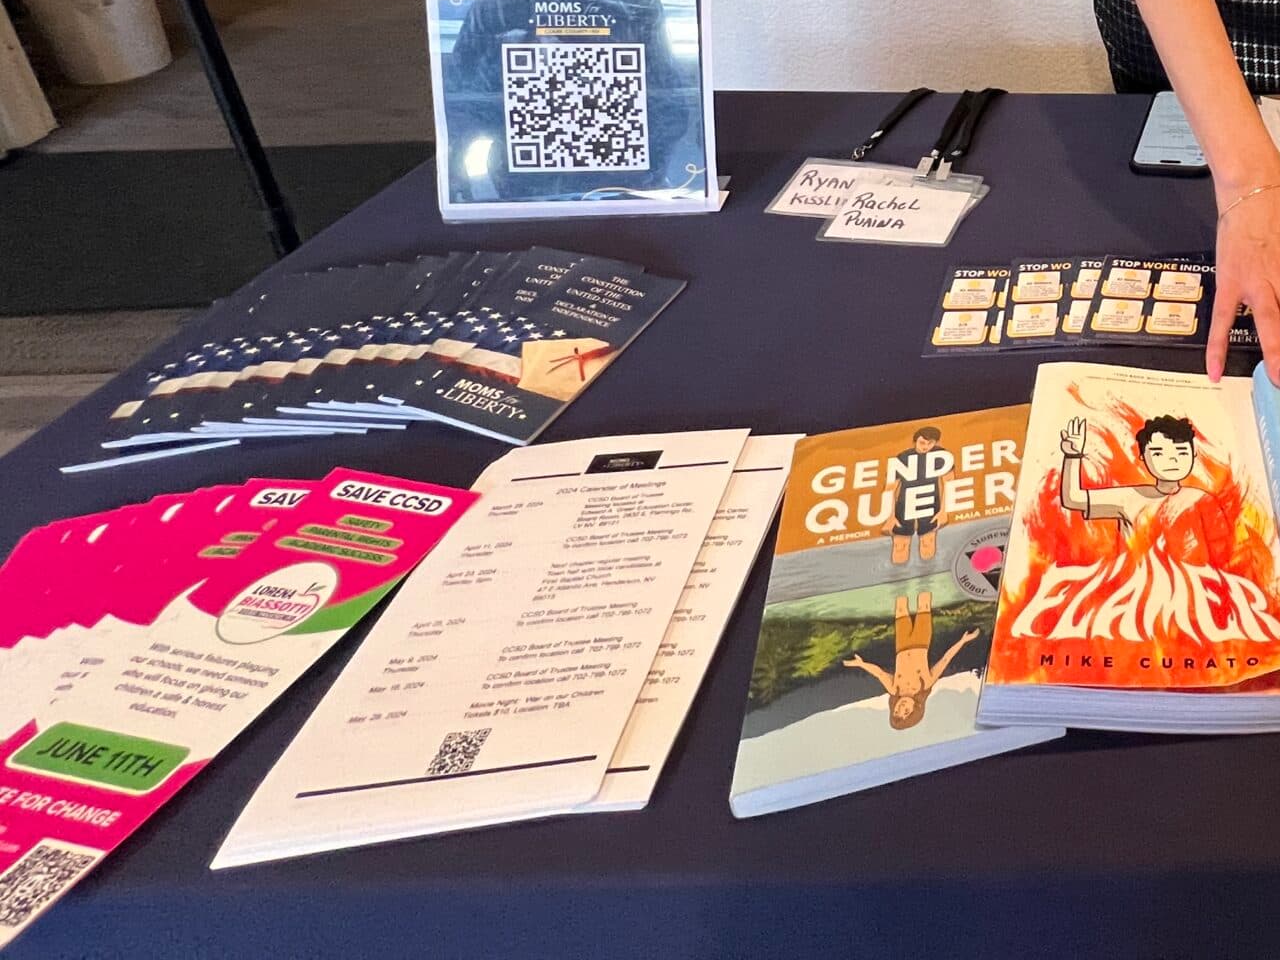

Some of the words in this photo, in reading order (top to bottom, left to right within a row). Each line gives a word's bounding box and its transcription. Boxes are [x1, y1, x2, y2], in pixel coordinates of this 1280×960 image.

[535, 2, 581, 13] MOMS
[536, 15, 612, 27] LIBERTY
[1112, 259, 1141, 268] STOP
[1143, 261, 1178, 271] WOKE
[1180, 264, 1217, 273] INDOC
[581, 276, 646, 298] CONSTITUTION
[611, 276, 630, 285] THE
[566, 287, 600, 301] UNITED
[600, 298, 632, 311] STATES
[606, 290, 623, 300] THE
[552, 306, 611, 328] INDEPENDENCE
[554, 300, 608, 321] DECLARATION
[454, 379, 504, 399] MOMS
[443, 388, 524, 418] LIBERTY
[811, 439, 1021, 495] GENDER
[258, 492, 306, 506] SAV
[337, 484, 389, 504] SAVE
[389, 493, 443, 514] CCSD
[805, 471, 1016, 534] QUEER
[955, 511, 980, 520] MAIA
[309, 526, 353, 541] PARENTAL
[358, 535, 391, 547] RIGHTS
[830, 530, 870, 542] MEMOIR
[288, 539, 337, 553] ACADEMIC
[341, 548, 383, 562] SUCCESS
[252, 585, 297, 599] LORENA
[240, 597, 313, 614] BIASSOTTI
[1040, 654, 1114, 668] MIKE
[1139, 657, 1260, 669] CURATO
[36, 737, 109, 766] JUNE
[108, 750, 164, 777] 11TH
[12, 791, 50, 812] FOR
[47, 798, 122, 828] CHANGE
